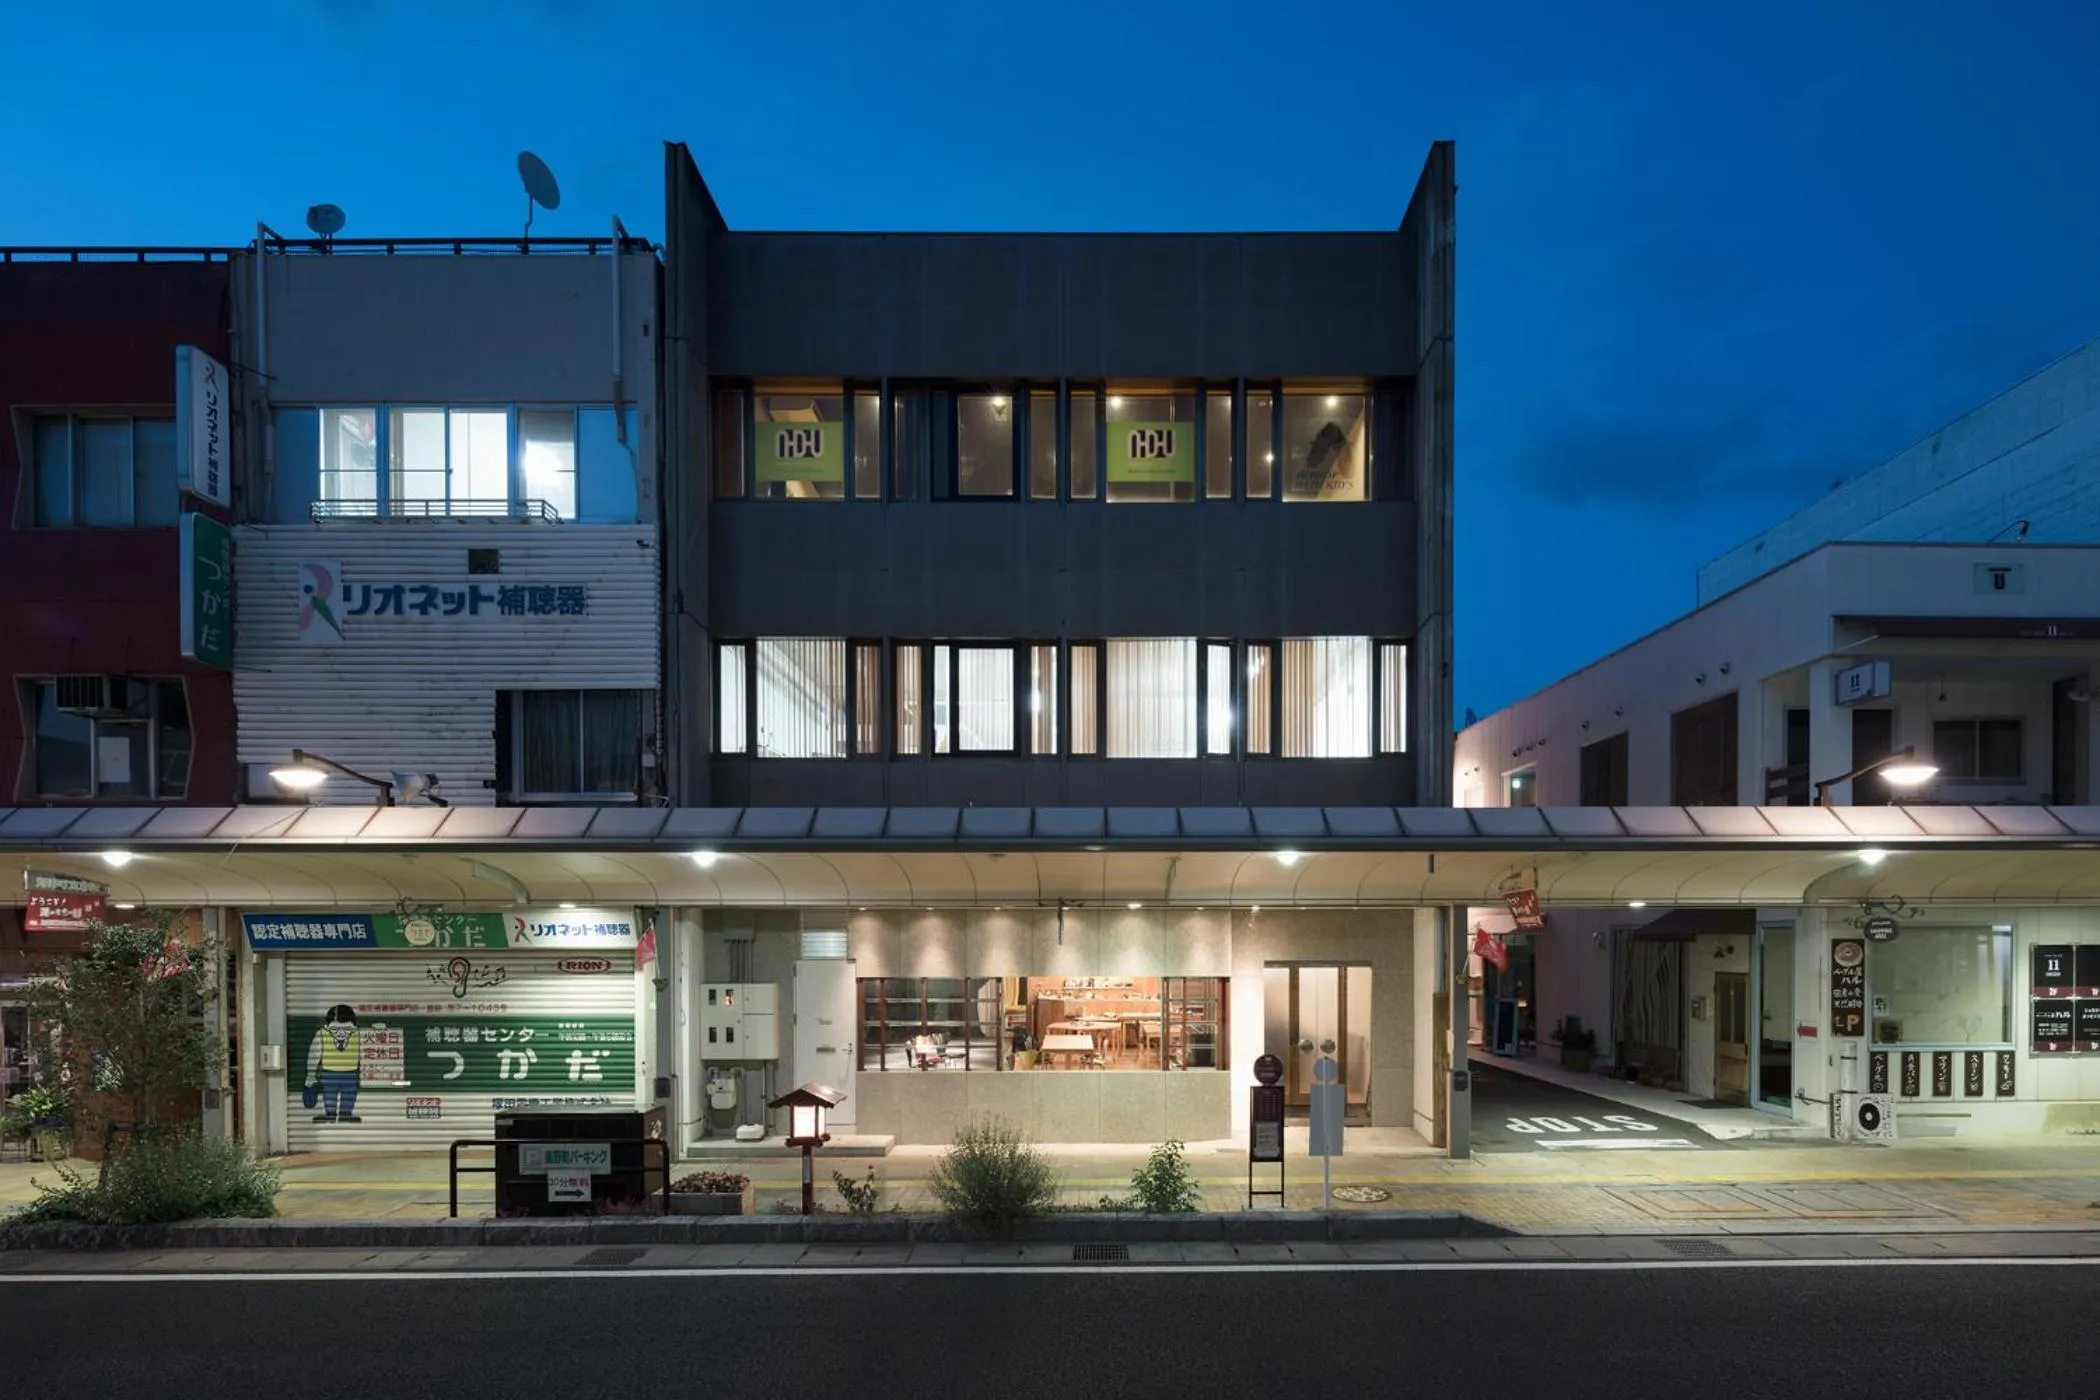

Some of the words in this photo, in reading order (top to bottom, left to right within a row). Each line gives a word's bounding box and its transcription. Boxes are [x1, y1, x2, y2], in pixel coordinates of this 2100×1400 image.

[197, 556, 222, 652] つかだ
[343, 585, 587, 616] リオネット補聴器
[251, 923, 368, 940] 認定補聴器専門店
[530, 923, 631, 937] リオネット補聴器
[566, 961, 602, 970] RION
[2048, 959, 2060, 971] 11
[1846, 1014, 1860, 1032] P
[363, 1031, 400, 1045] 火曜日
[425, 1027, 550, 1043] 補聴器センター
[363, 1047, 400, 1060] 定休日
[426, 1048, 612, 1081] つかだ
[1505, 1115, 1659, 1134] STOP
